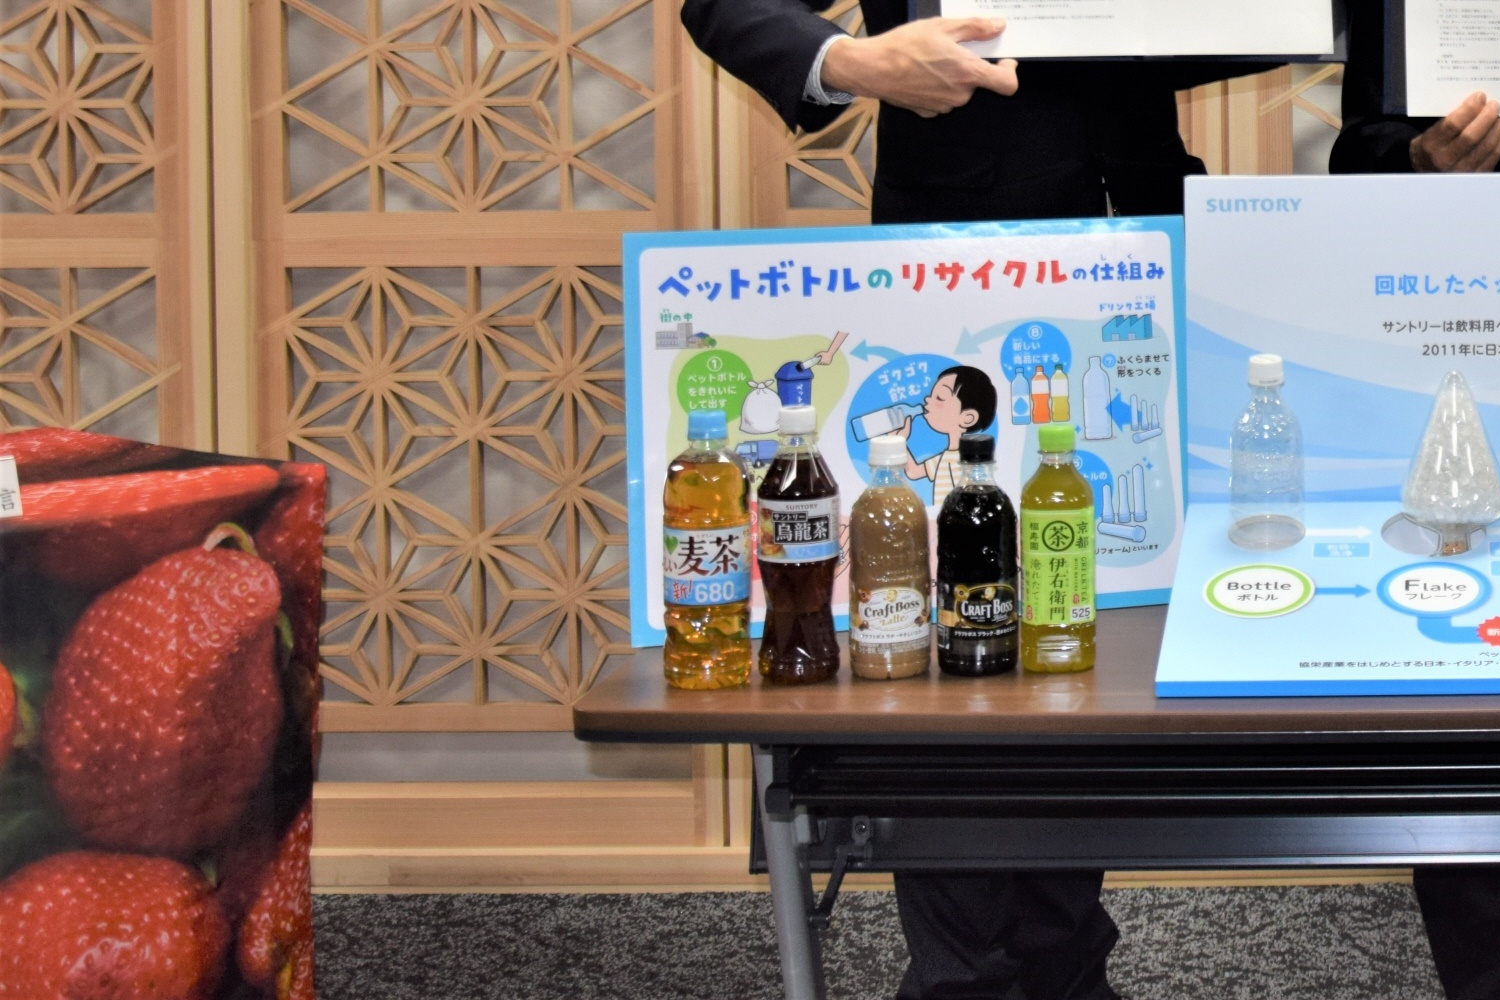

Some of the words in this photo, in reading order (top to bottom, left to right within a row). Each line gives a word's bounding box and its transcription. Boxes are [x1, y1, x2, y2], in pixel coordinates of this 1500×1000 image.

[658, 259, 1165, 301] ペットボトルのリサイクルの仕組み
[1117, 353, 1170, 364] ふくらませて
[687, 372, 747, 385] ペットボトル
[878, 361, 928, 386] ゴクゴク
[1075, 521, 1089, 549] 京都
[678, 535, 741, 577] 麦茶
[694, 581, 735, 604] 680
[1048, 557, 1067, 621] 伊右衛門
[1227, 582, 1292, 592] Bottle
[1404, 579, 1468, 593] Flake
[1237, 594, 1279, 602] ボトル
[1405, 593, 1463, 601] フレーク
[864, 603, 895, 618] Craft
[895, 599, 920, 613] Boss
[1071, 607, 1091, 619] 525
